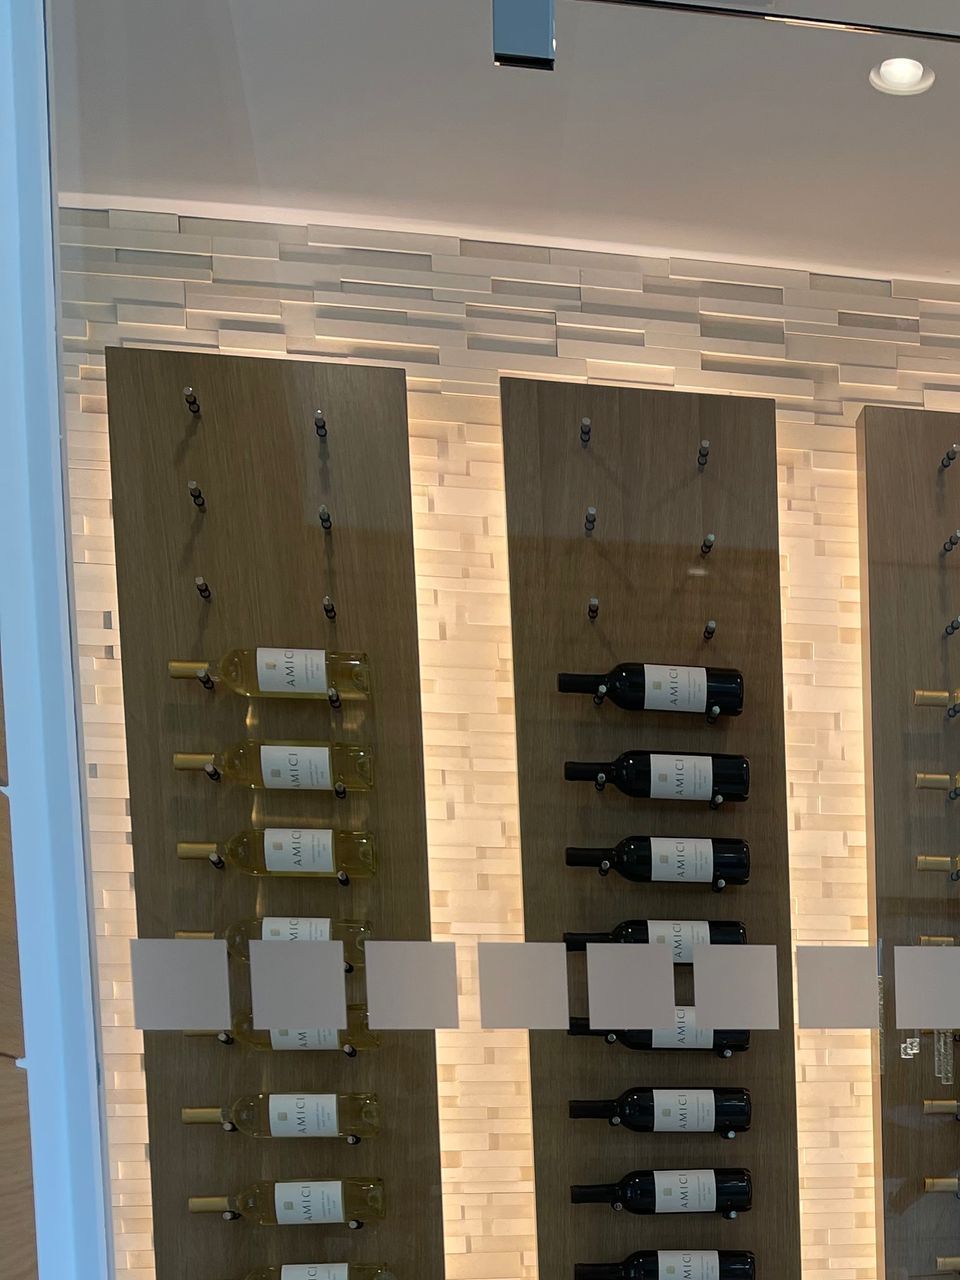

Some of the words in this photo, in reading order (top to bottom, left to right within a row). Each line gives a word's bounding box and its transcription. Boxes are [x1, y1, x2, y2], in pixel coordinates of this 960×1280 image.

[669, 668, 678, 705] AMICI
[675, 759, 684, 795] AMICI
[676, 842, 685, 878] AMICI
[289, 918, 299, 941] MIC
[673, 923, 683, 958] AMICI
[676, 1008, 686, 1044] AMICI
[296, 1097, 307, 1134] AMICI
[678, 1094, 688, 1129] AMICI
[301, 1186, 312, 1221] AMICI
[679, 1175, 688, 1209] AMICI
